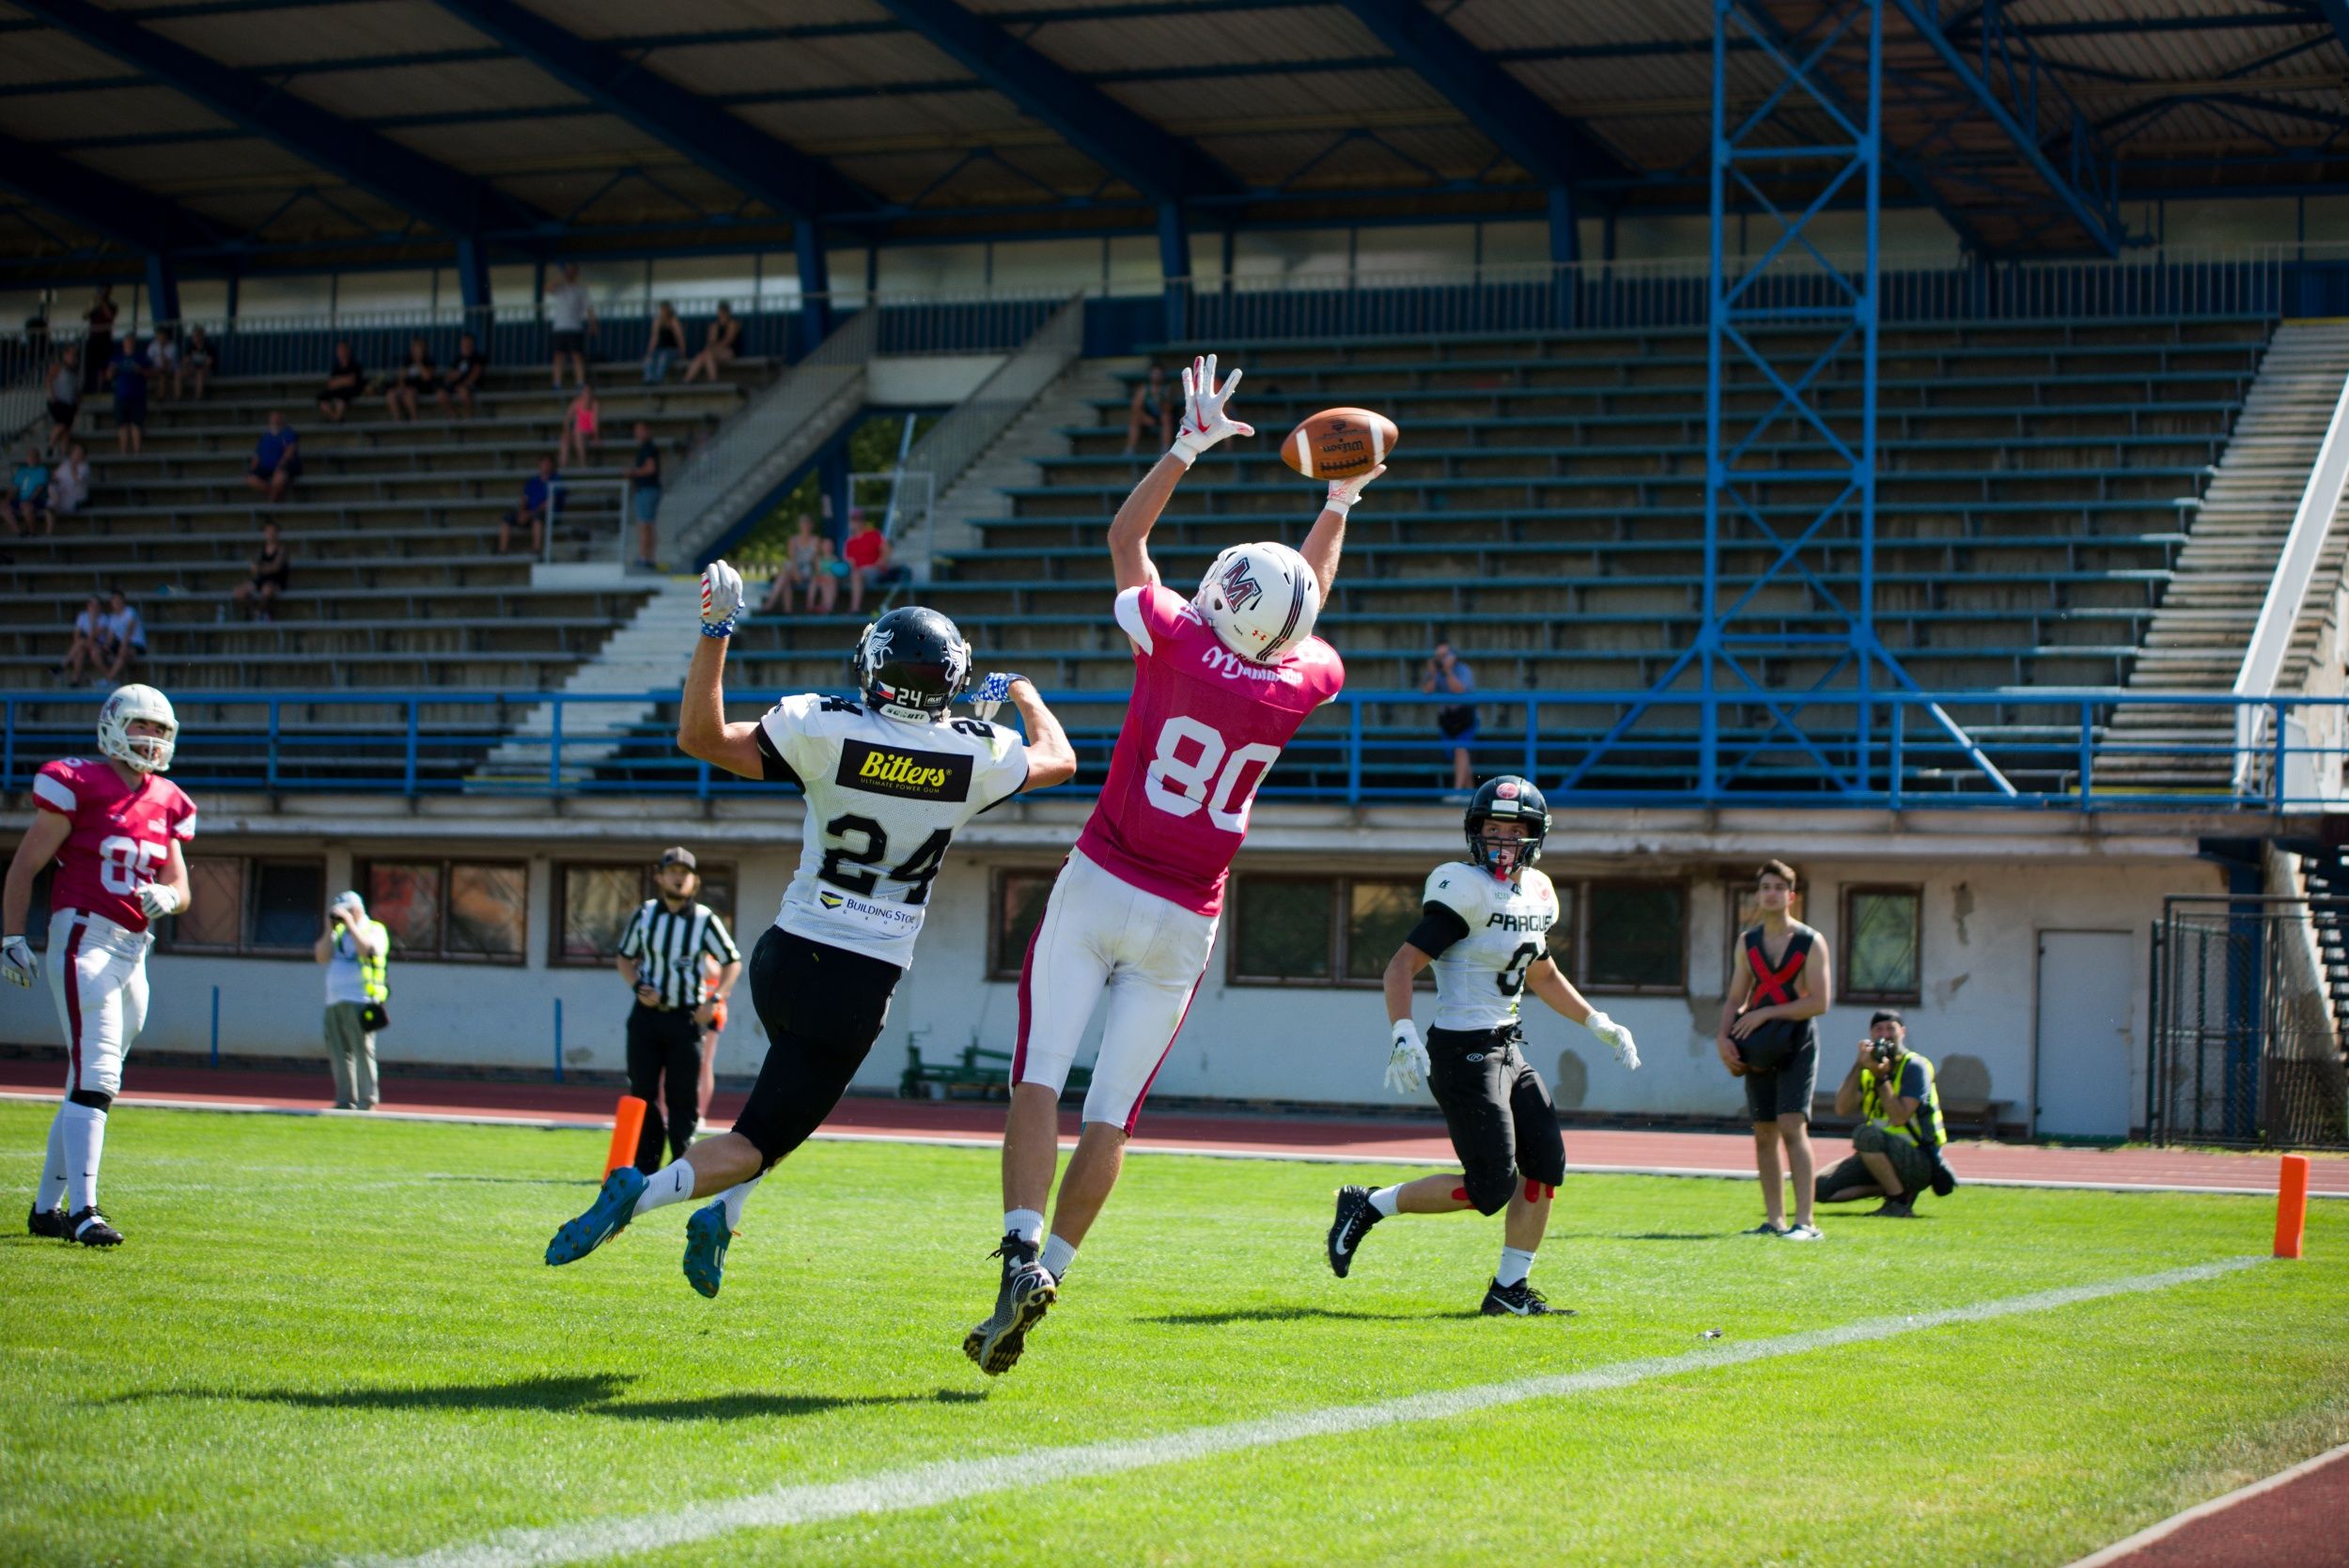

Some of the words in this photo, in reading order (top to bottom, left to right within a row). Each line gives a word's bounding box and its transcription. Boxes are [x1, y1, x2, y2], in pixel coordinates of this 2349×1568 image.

[1323, 440, 1363, 452] Wilson
[1202, 645, 1303, 685] Mamms
[896, 687, 923, 707] 24
[861, 776, 893, 789] ULTIMATE
[895, 783, 921, 792] POWER
[1144, 715, 1282, 834] 80
[100, 835, 167, 896] 85
[817, 814, 954, 905] 24
[847, 898, 893, 919] BUILDING
[1486, 912, 1552, 932] PRAGUE
